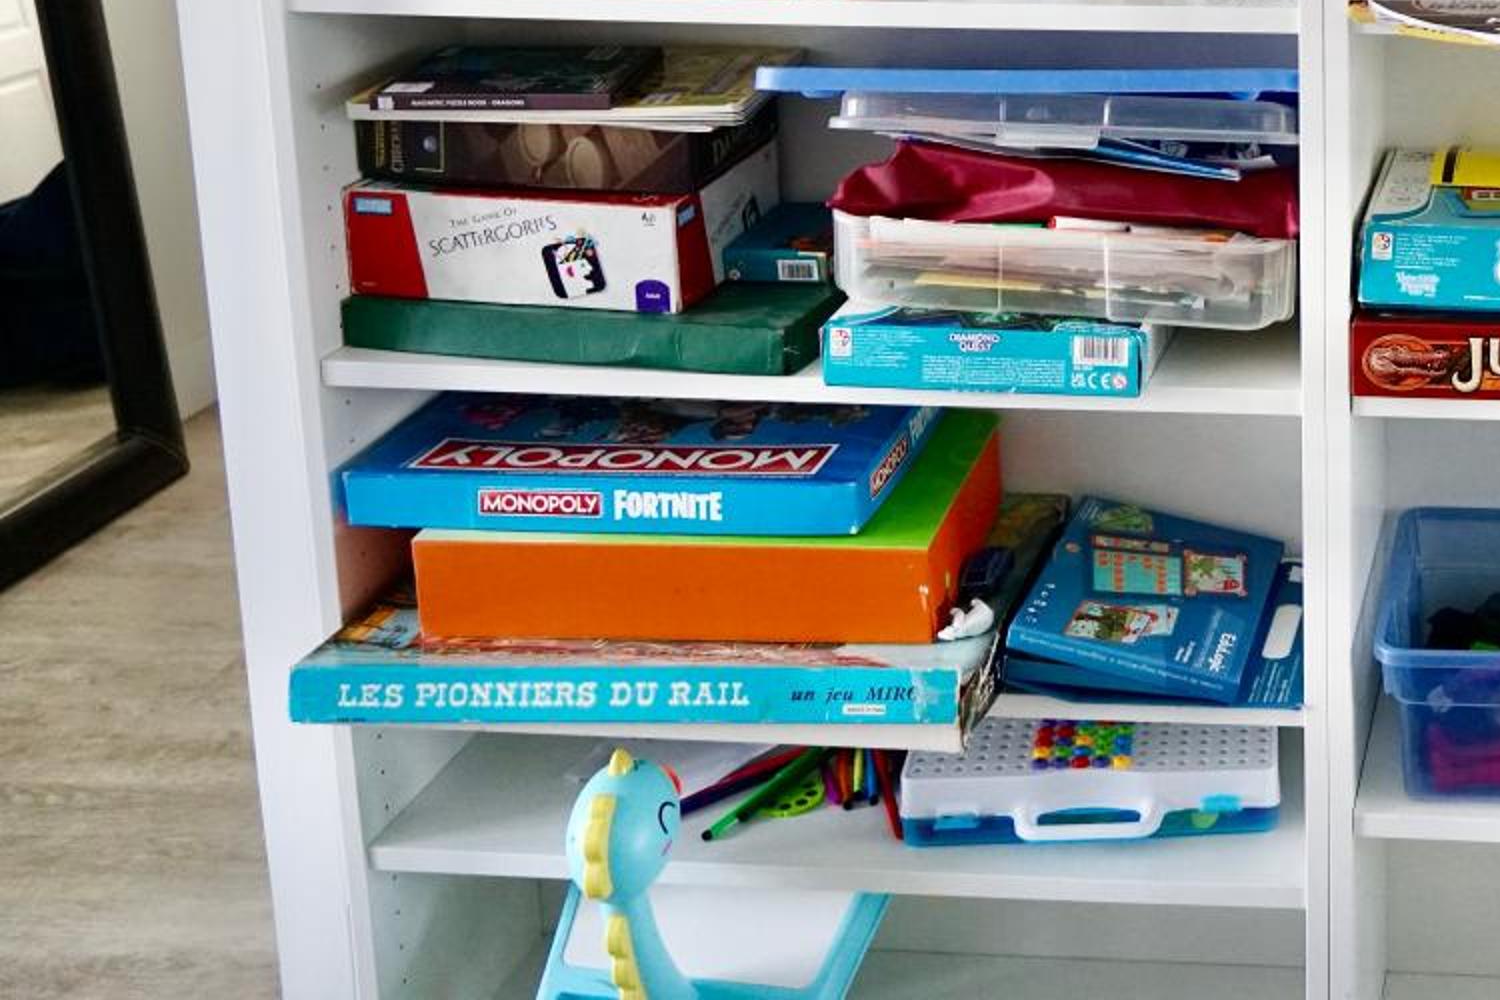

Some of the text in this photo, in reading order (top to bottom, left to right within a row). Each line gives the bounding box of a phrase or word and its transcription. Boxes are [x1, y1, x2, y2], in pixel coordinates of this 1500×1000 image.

[430, 444, 818, 471] MONOPOLY
[482, 493, 599, 515] MONOPOLY
[613, 489, 723, 522] FORTNITE
[337, 683, 404, 708] LES
[415, 681, 598, 708] PIONNIERS
[610, 681, 658, 707] DU
[668, 681, 750, 707] RAIL
[790, 689, 816, 702] un
[825, 687, 854, 705] jeu
